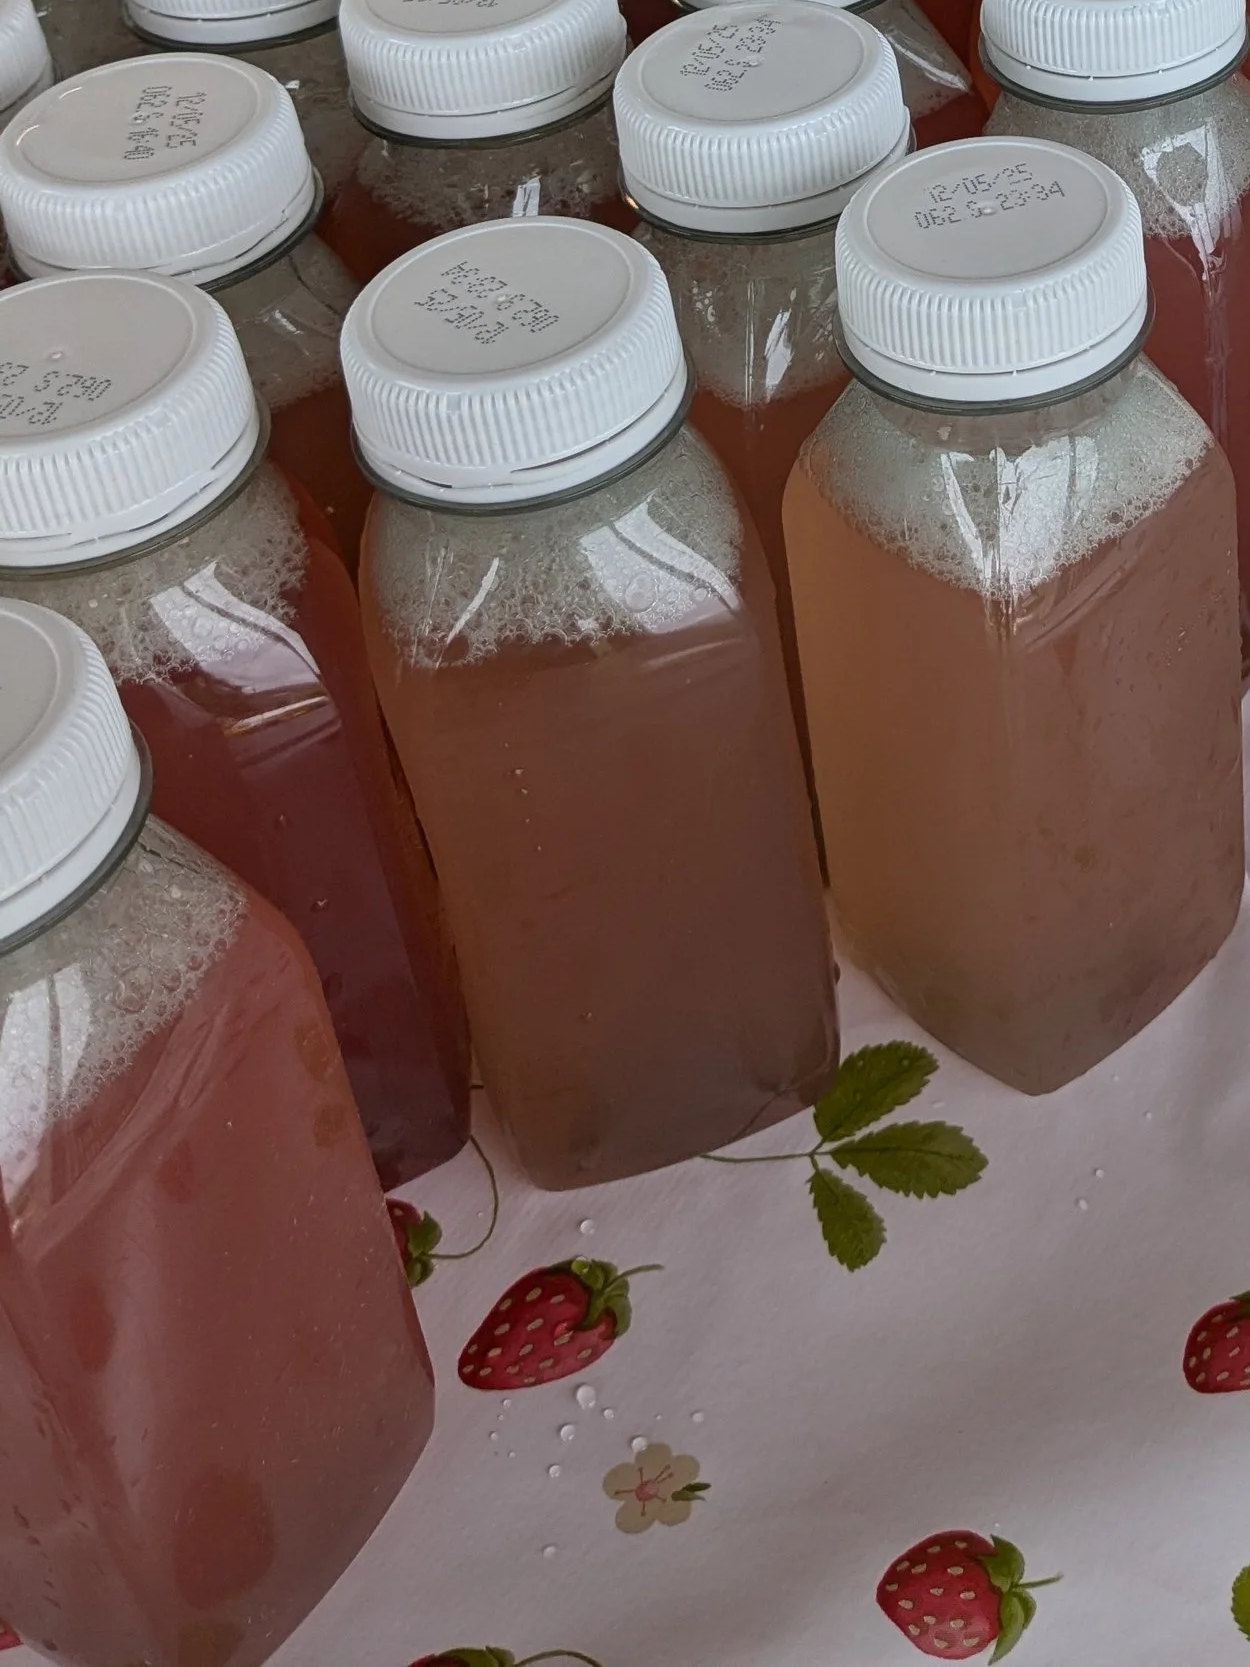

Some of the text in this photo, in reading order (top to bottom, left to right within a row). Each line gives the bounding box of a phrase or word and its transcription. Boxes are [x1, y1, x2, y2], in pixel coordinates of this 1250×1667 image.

[680, 24, 739, 76] 12/05/25
[166, 92, 207, 148] 12/05/25
[923, 163, 1032, 203] 12/05/25
[995, 181, 1064, 211] 23:34
[414, 289, 509, 344] 12/05/25
